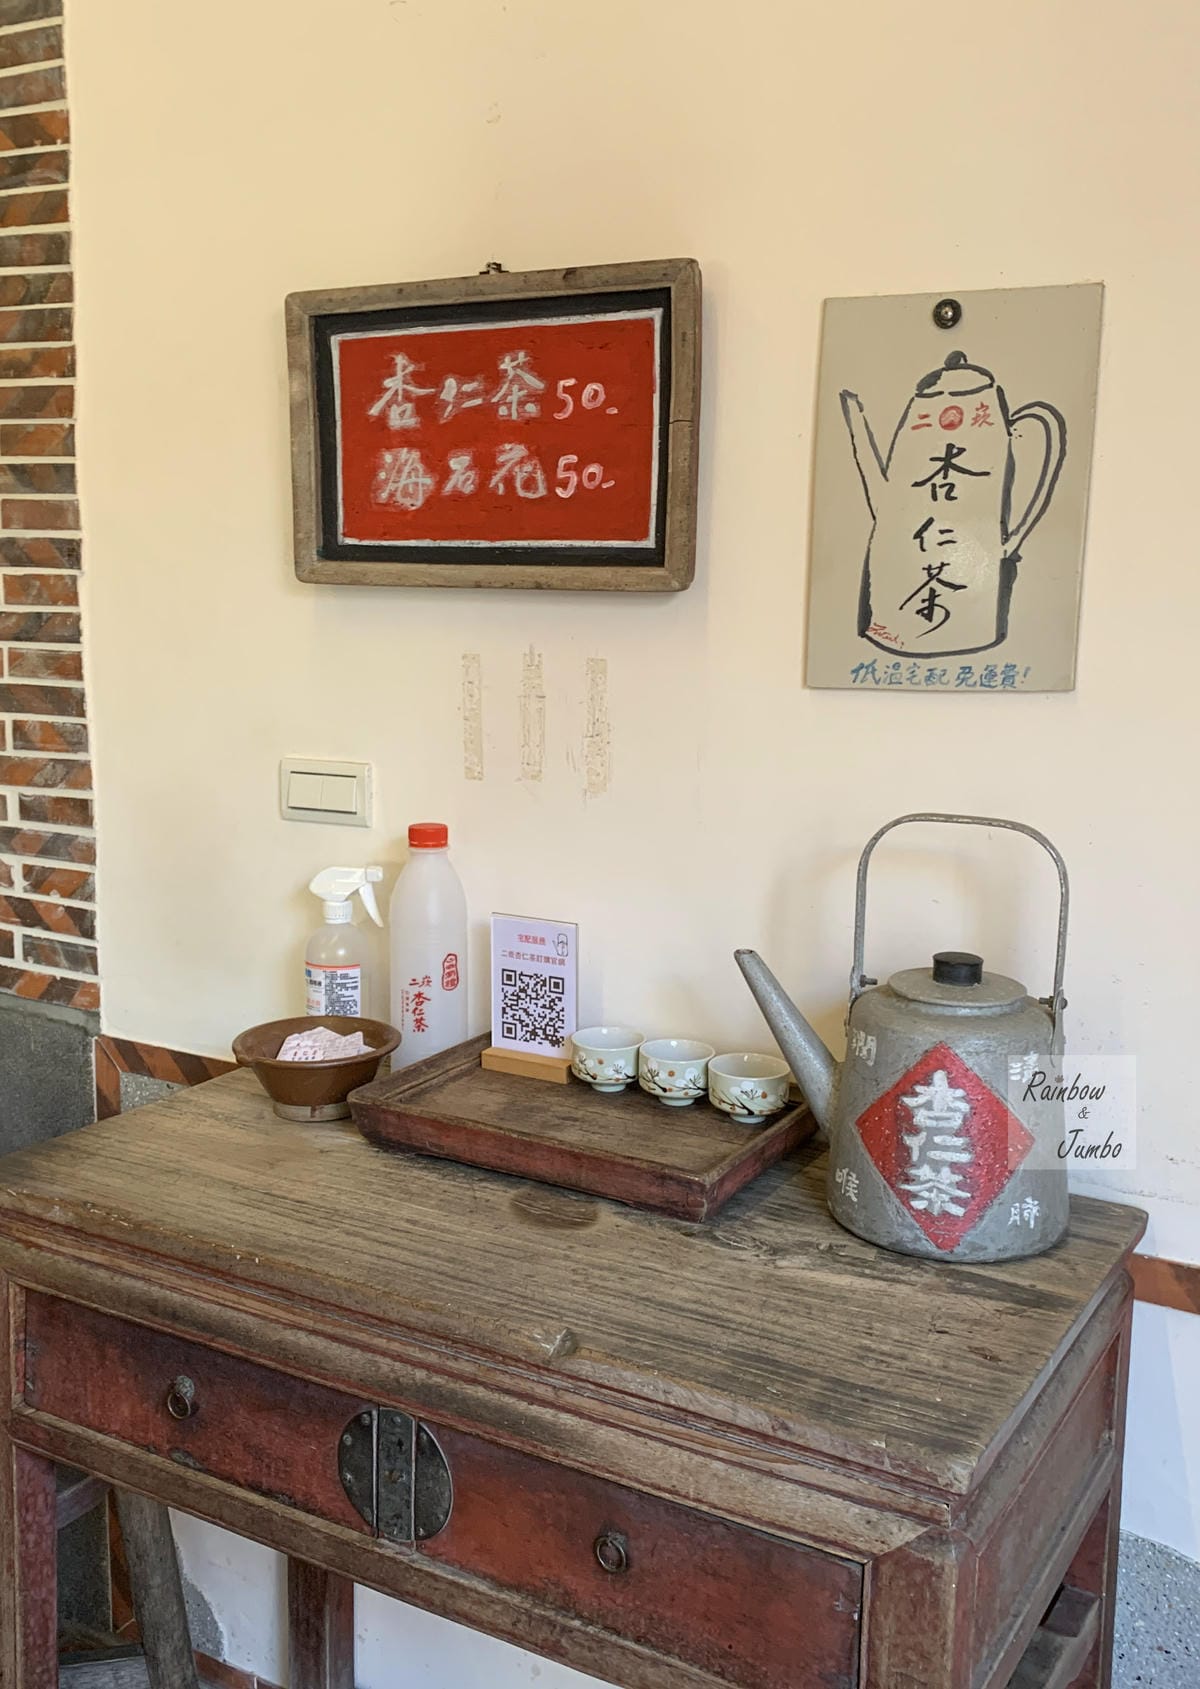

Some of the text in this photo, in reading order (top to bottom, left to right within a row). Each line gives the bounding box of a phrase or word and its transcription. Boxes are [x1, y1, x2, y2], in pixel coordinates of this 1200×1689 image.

[368, 352, 545, 428] 杏仁茶
[375, 444, 547, 509] 海石花
[899, 443, 990, 638] 杏仁茶
[410, 991, 431, 1033] 杏仁茶
[900, 1069, 973, 1217] 杏仁茶
